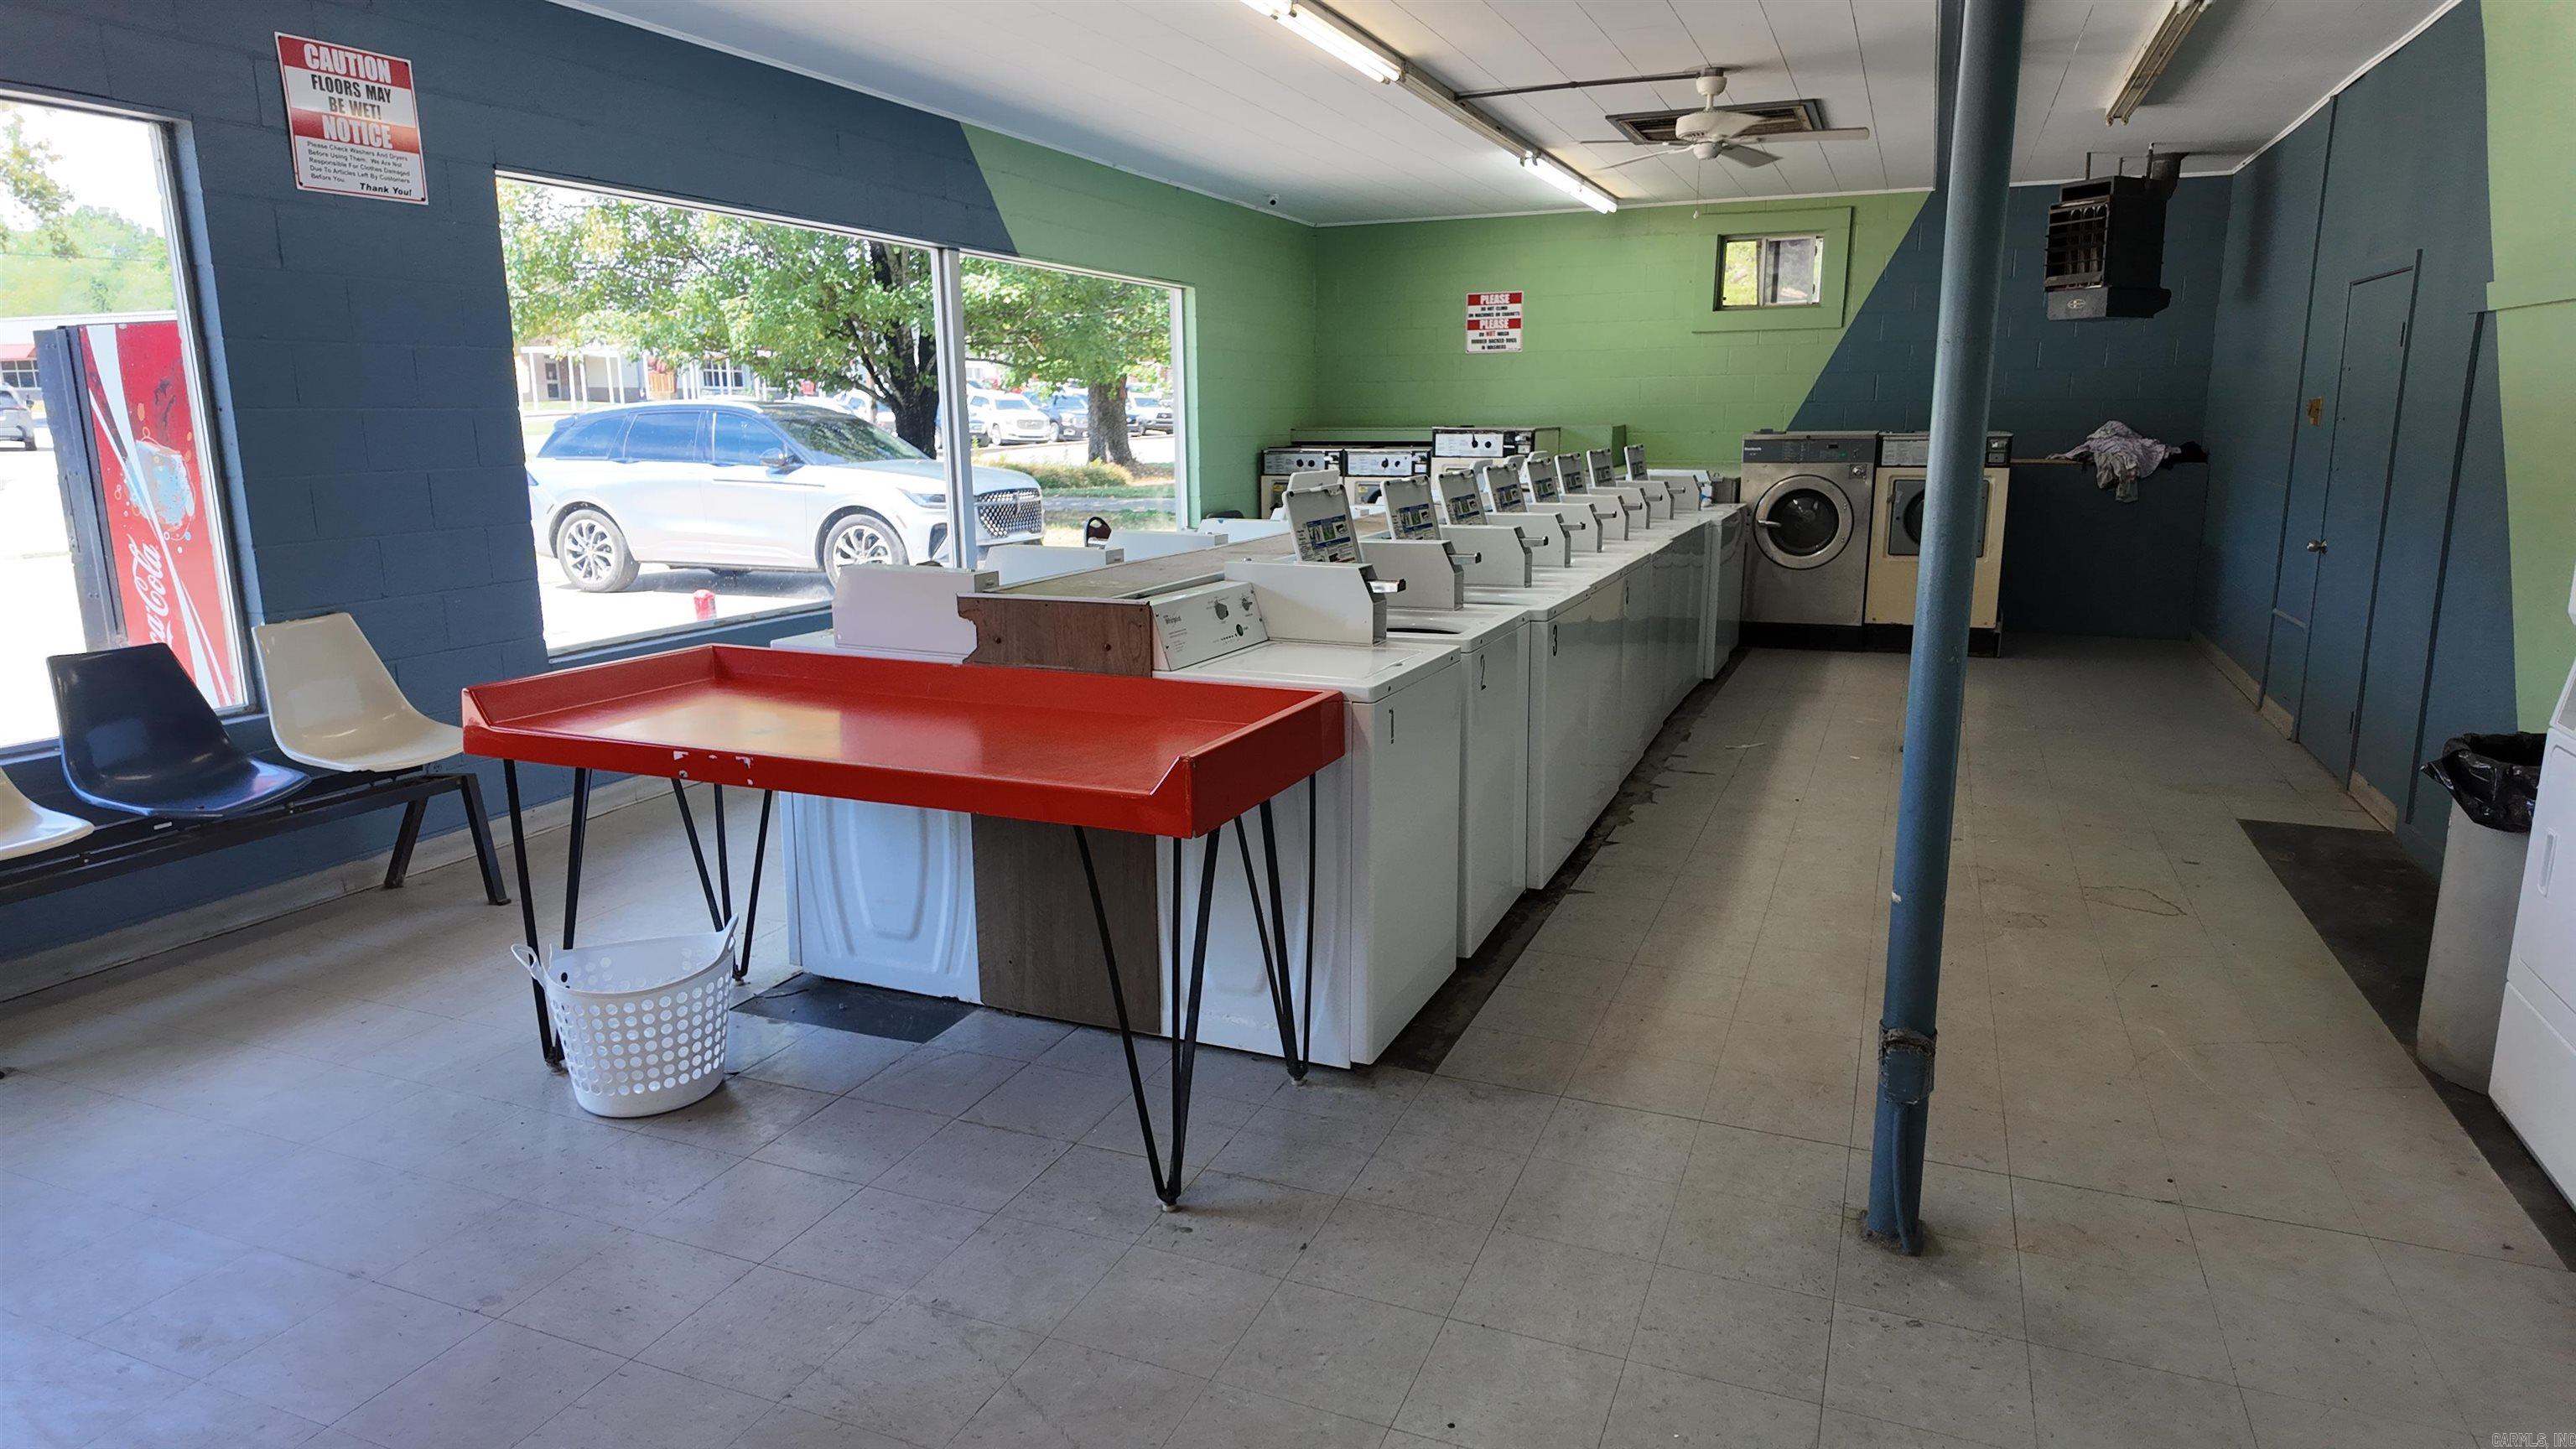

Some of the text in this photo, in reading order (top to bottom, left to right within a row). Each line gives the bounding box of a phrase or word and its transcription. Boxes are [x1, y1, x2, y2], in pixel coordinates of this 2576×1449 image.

[304, 44, 391, 83] CAUTION
[311, 74, 391, 103] FLOORS MAY
[329, 96, 381, 120] BE WET!
[322, 115, 392, 148] NOTICE
[308, 141, 327, 149] Please
[330, 152, 347, 161] Using
[309, 158, 347, 168] Responsible
[384, 168, 410, 177] Damaged
[360, 182, 388, 193] Thank
[392, 187, 412, 196] You!
[380, 175, 410, 184] Customers
[1480, 294, 1509, 304] PLEASE
[1480, 319, 1509, 329] PLEASE
[1553, 625, 1557, 656] 3
[1480, 654, 1486, 690] 2
[1389, 708, 1394, 744] 1
